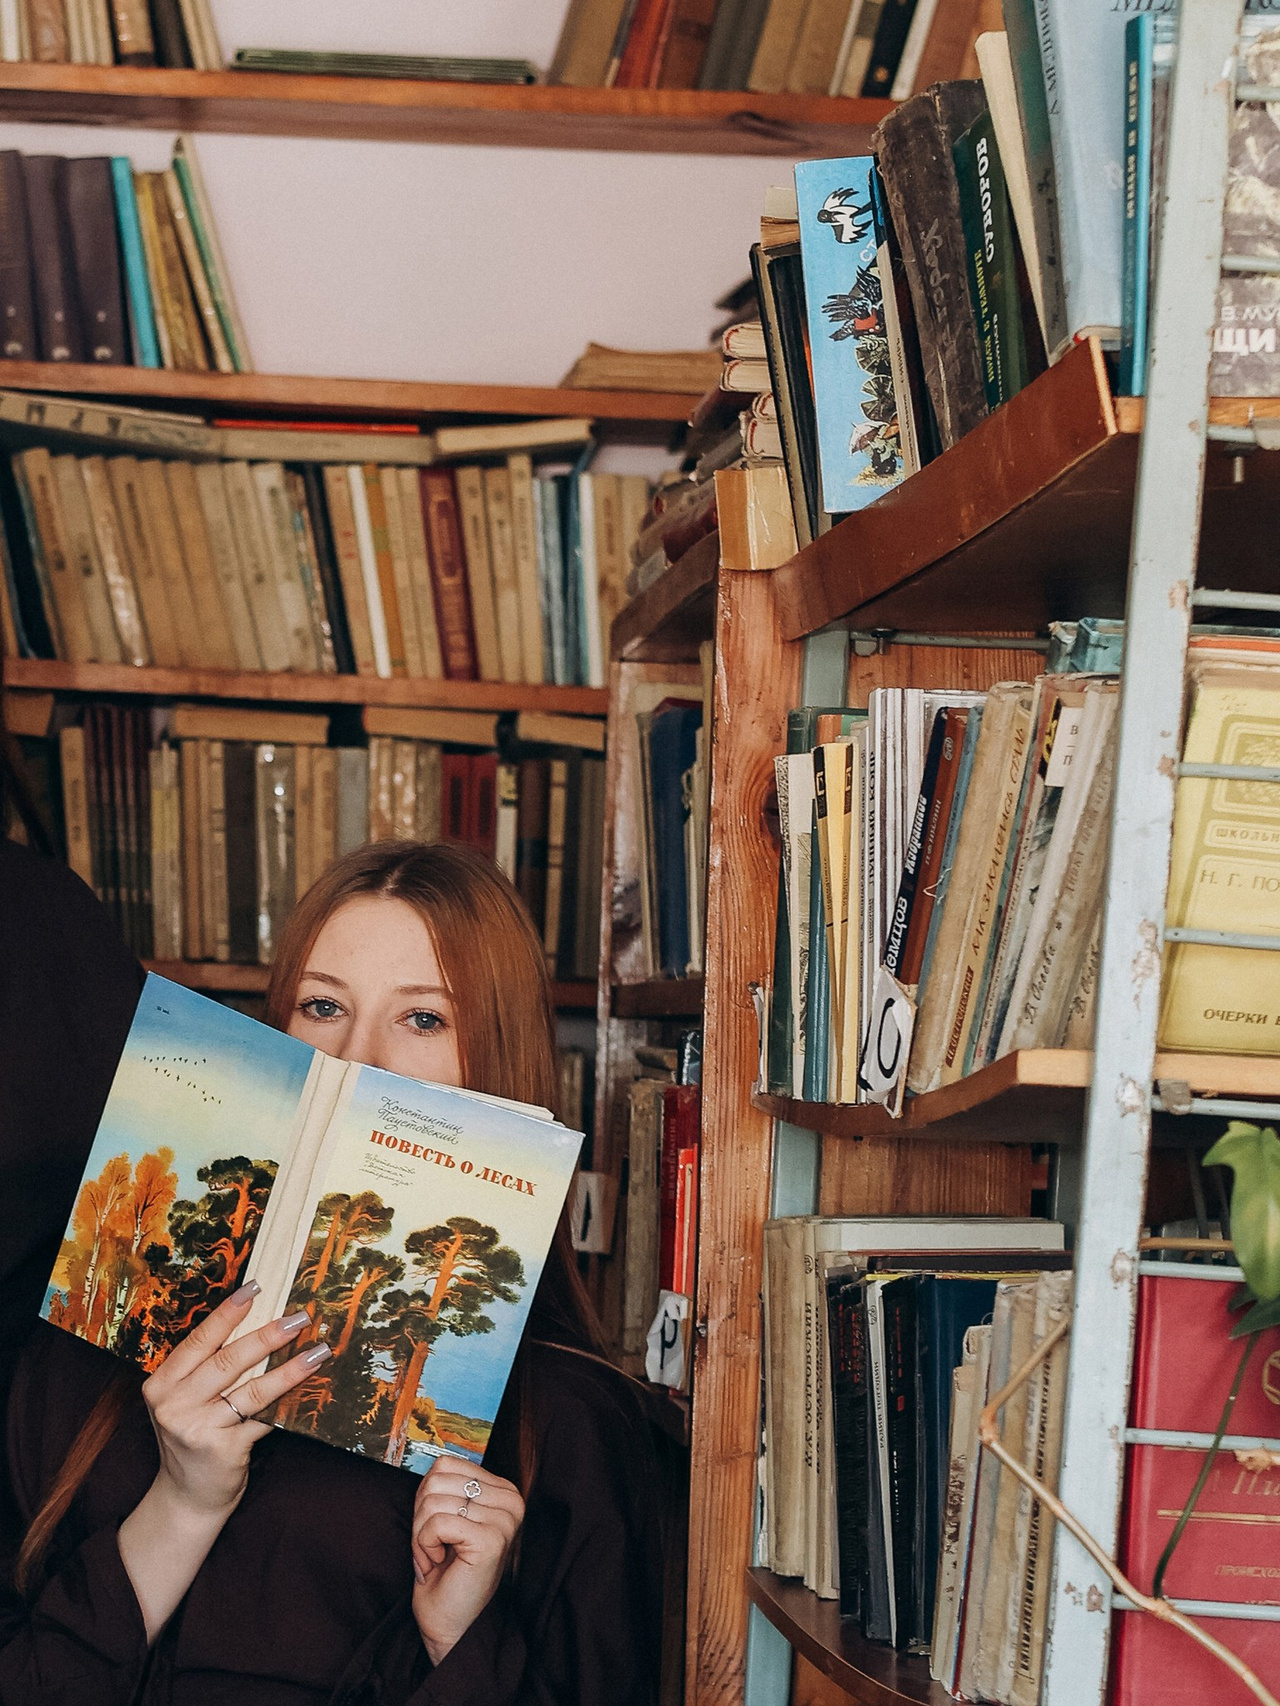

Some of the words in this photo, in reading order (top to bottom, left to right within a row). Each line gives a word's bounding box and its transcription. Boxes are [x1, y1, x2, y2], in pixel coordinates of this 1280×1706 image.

[976, 137, 995, 263] СУВОРОВ
[1200, 868, 1217, 885] Н.
[1228, 872, 1243, 888] Г.
[1203, 1008, 1268, 1027] ОЧЕРКИ
[378, 1108, 459, 1145] Паустовский
[380, 1095, 464, 1135] Константин
[369, 1129, 457, 1169] ПОВЕСТЬ
[460, 1160, 474, 1175] О
[475, 1166, 538, 1197] ЛЕСАХ
